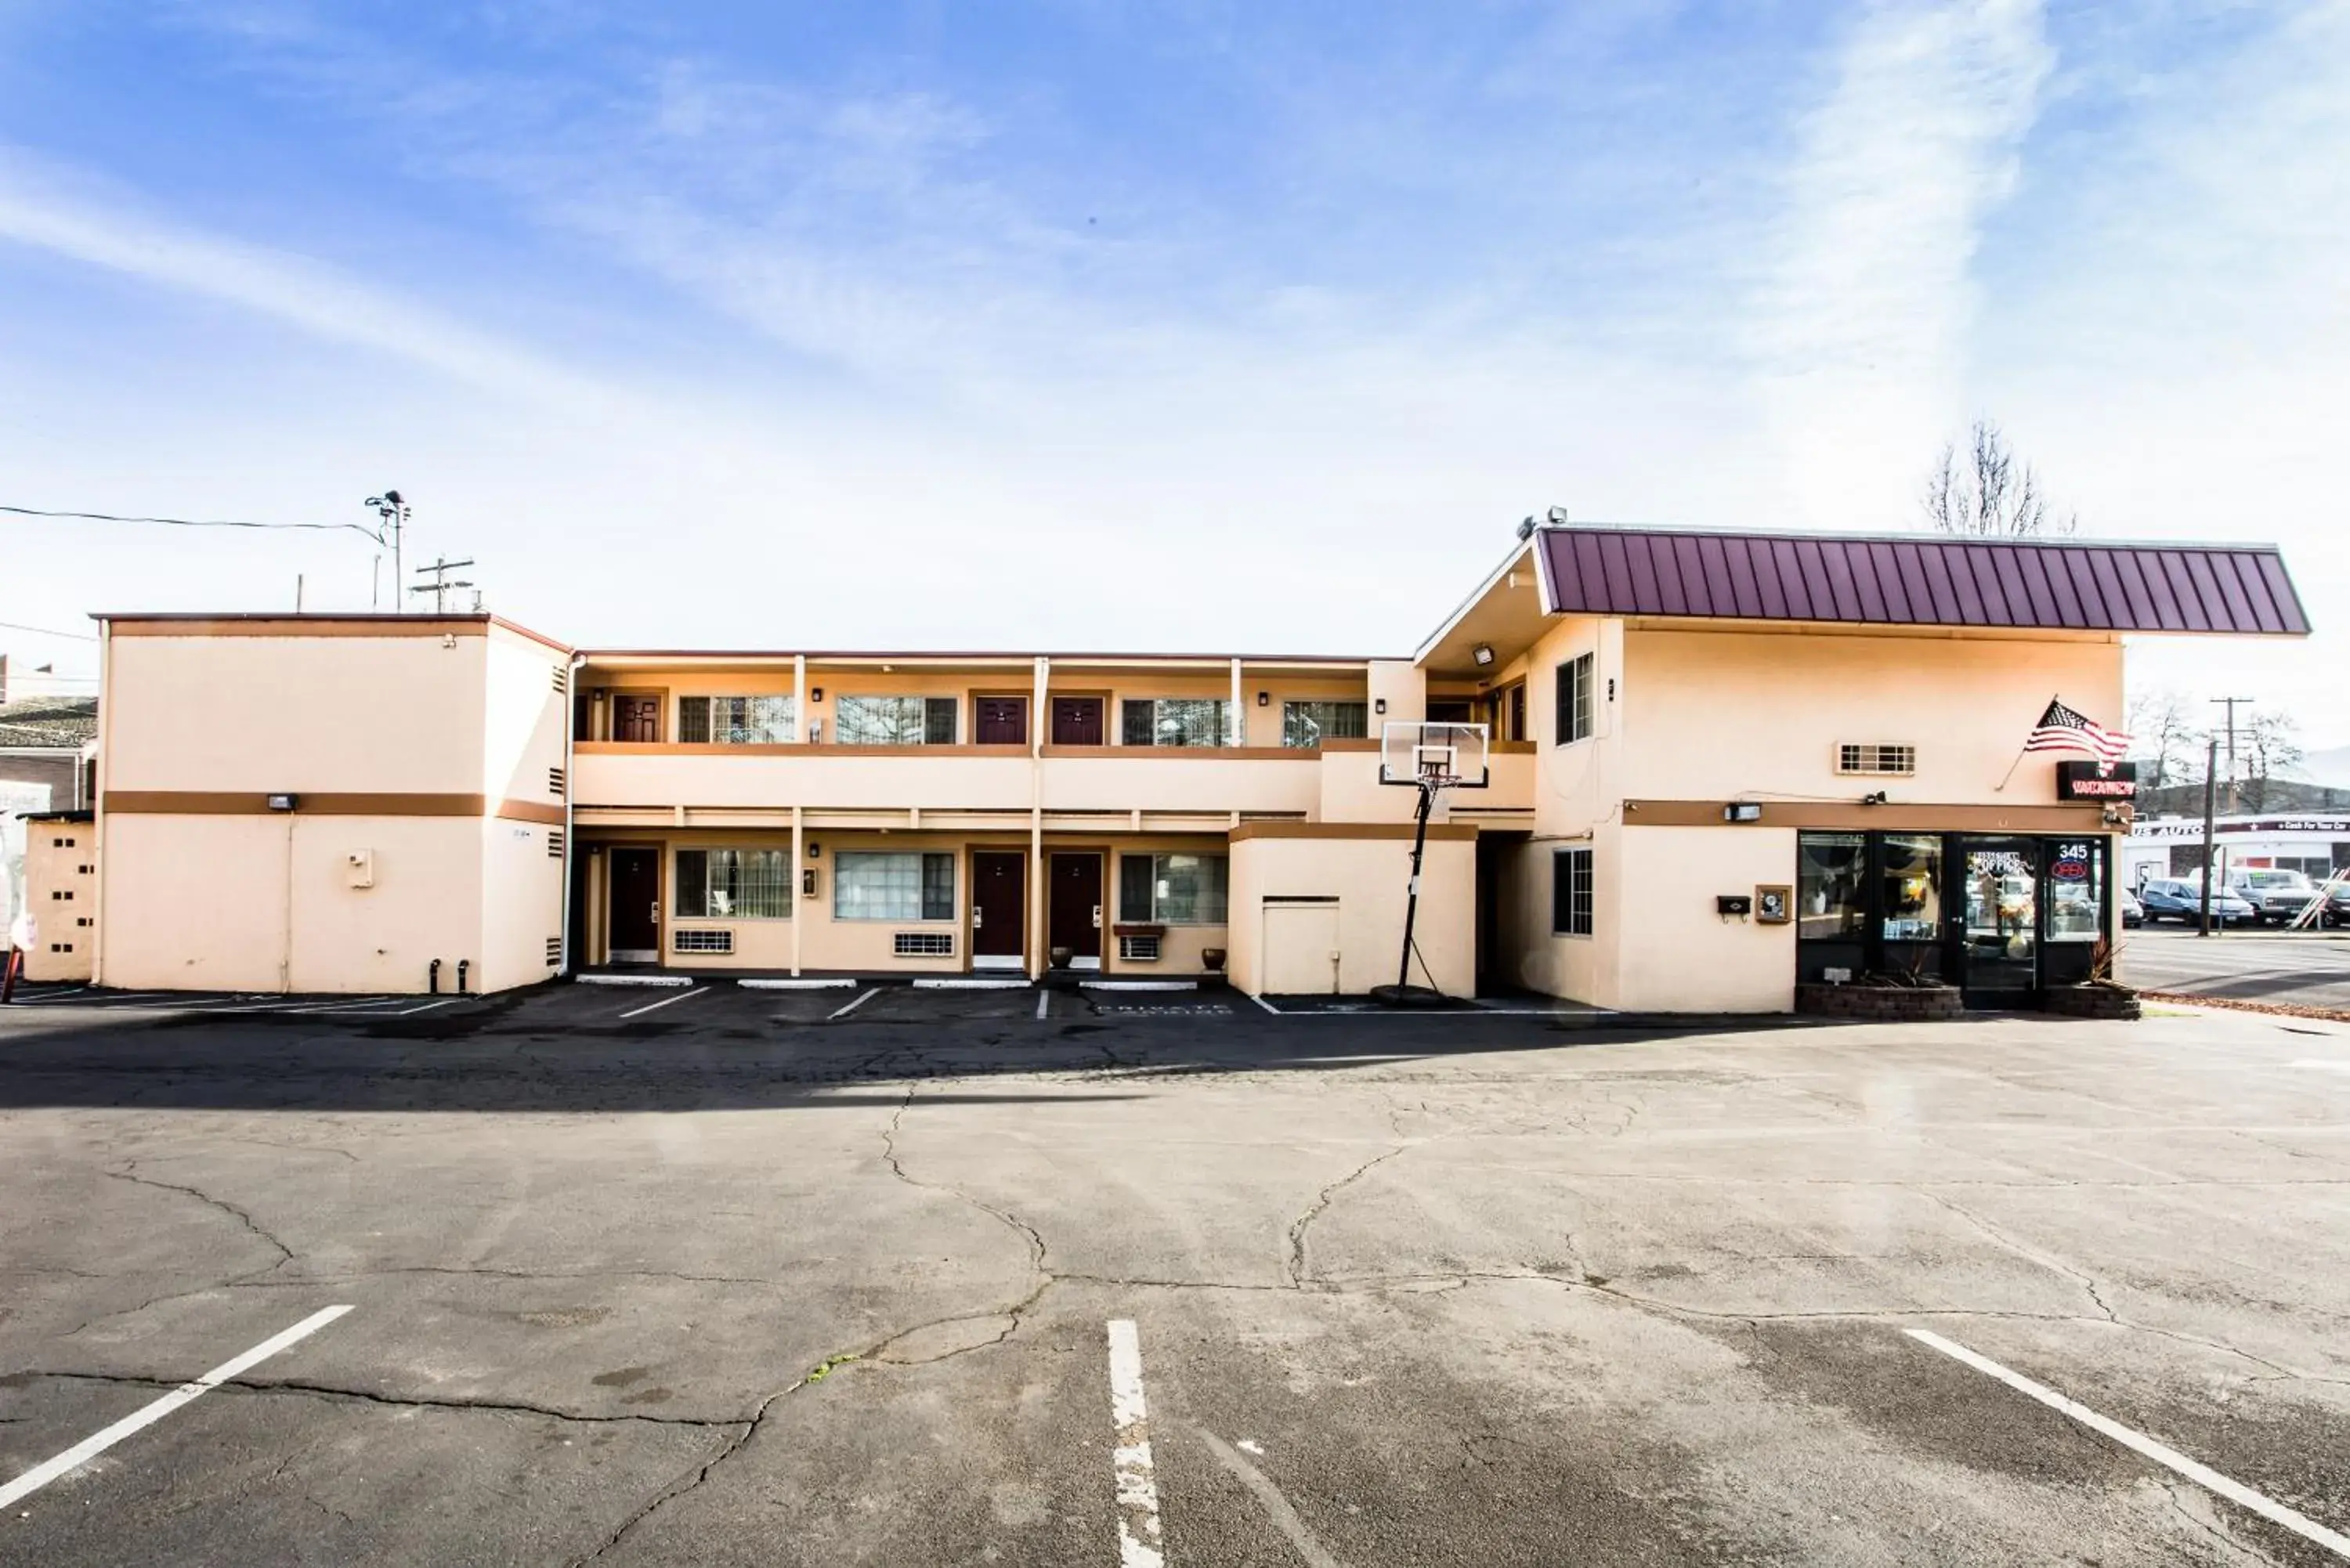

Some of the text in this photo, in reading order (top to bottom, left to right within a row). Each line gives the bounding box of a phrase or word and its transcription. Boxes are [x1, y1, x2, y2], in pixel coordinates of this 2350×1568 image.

[2072, 780, 2135, 795] VACANCY
[2059, 844, 2088, 859] 345
[1982, 859, 2020, 872] OFFICE
[2055, 864, 2084, 876] OPEN
